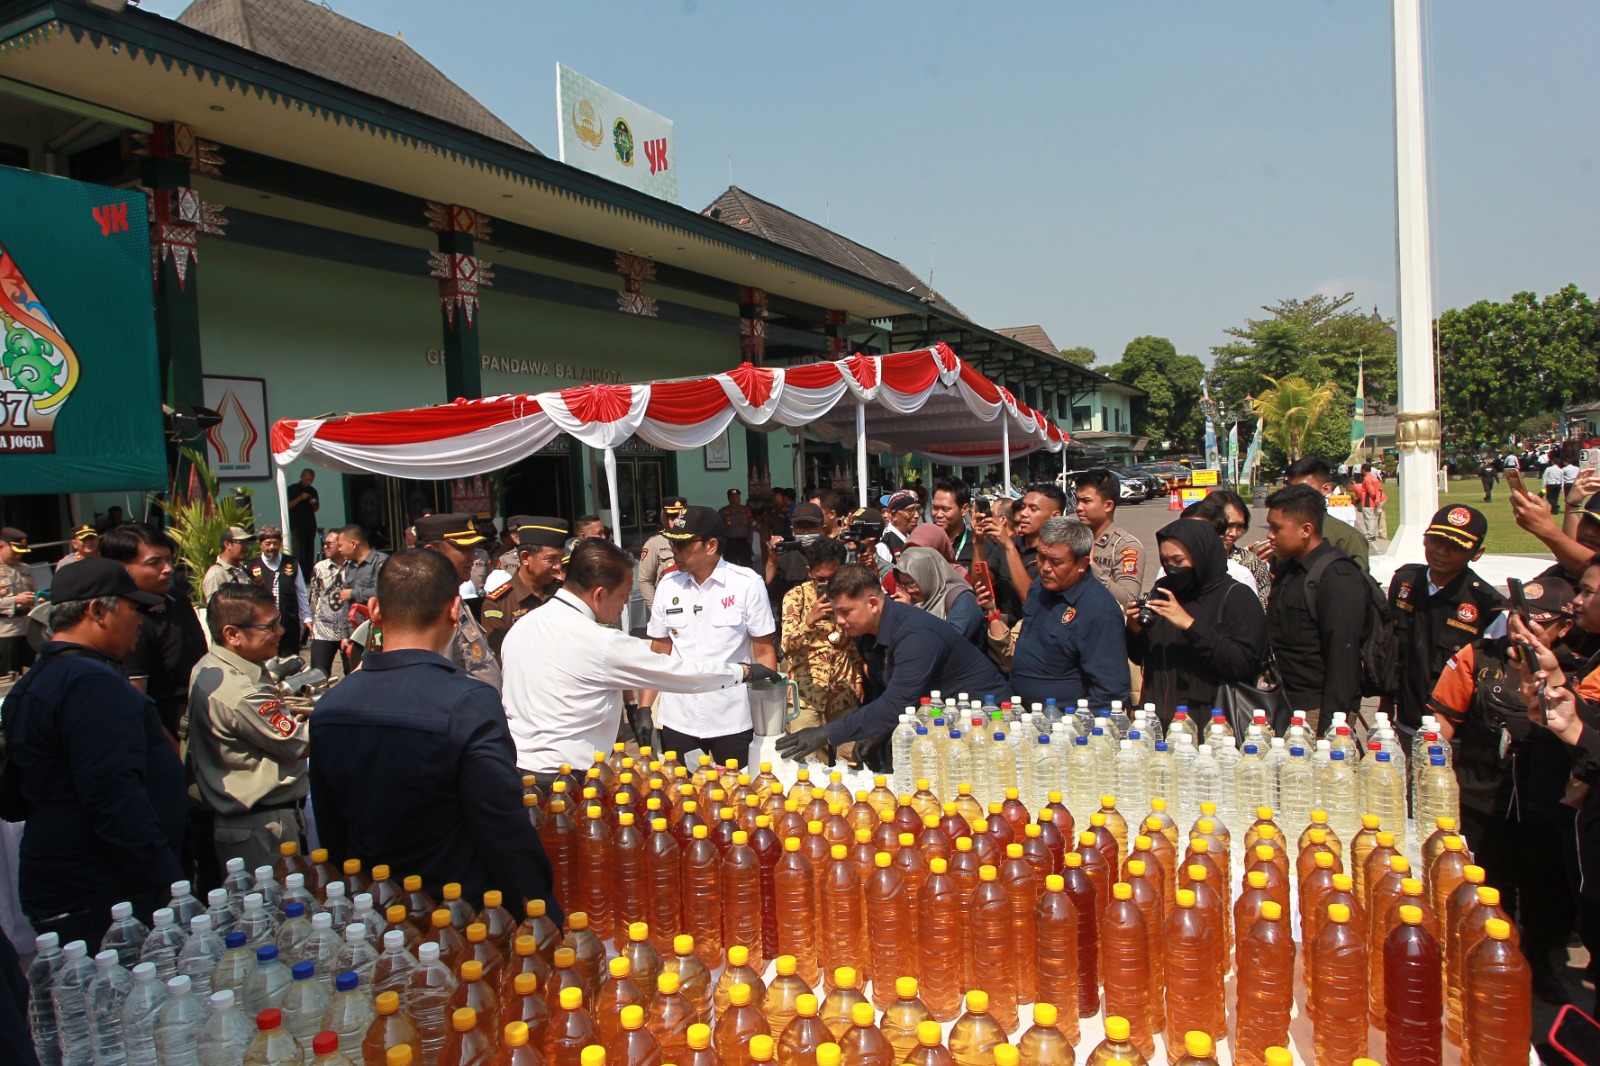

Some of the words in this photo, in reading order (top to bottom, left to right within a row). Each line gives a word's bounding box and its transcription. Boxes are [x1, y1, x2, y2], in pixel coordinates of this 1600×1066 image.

[644, 138, 668, 176] YK
[92, 202, 129, 237] YK
[480, 354, 549, 376] PANDAWA
[554, 363, 625, 385] BALAIKOTA
[10, 435, 45, 450] JOGJA
[721, 595, 735, 609] YK
